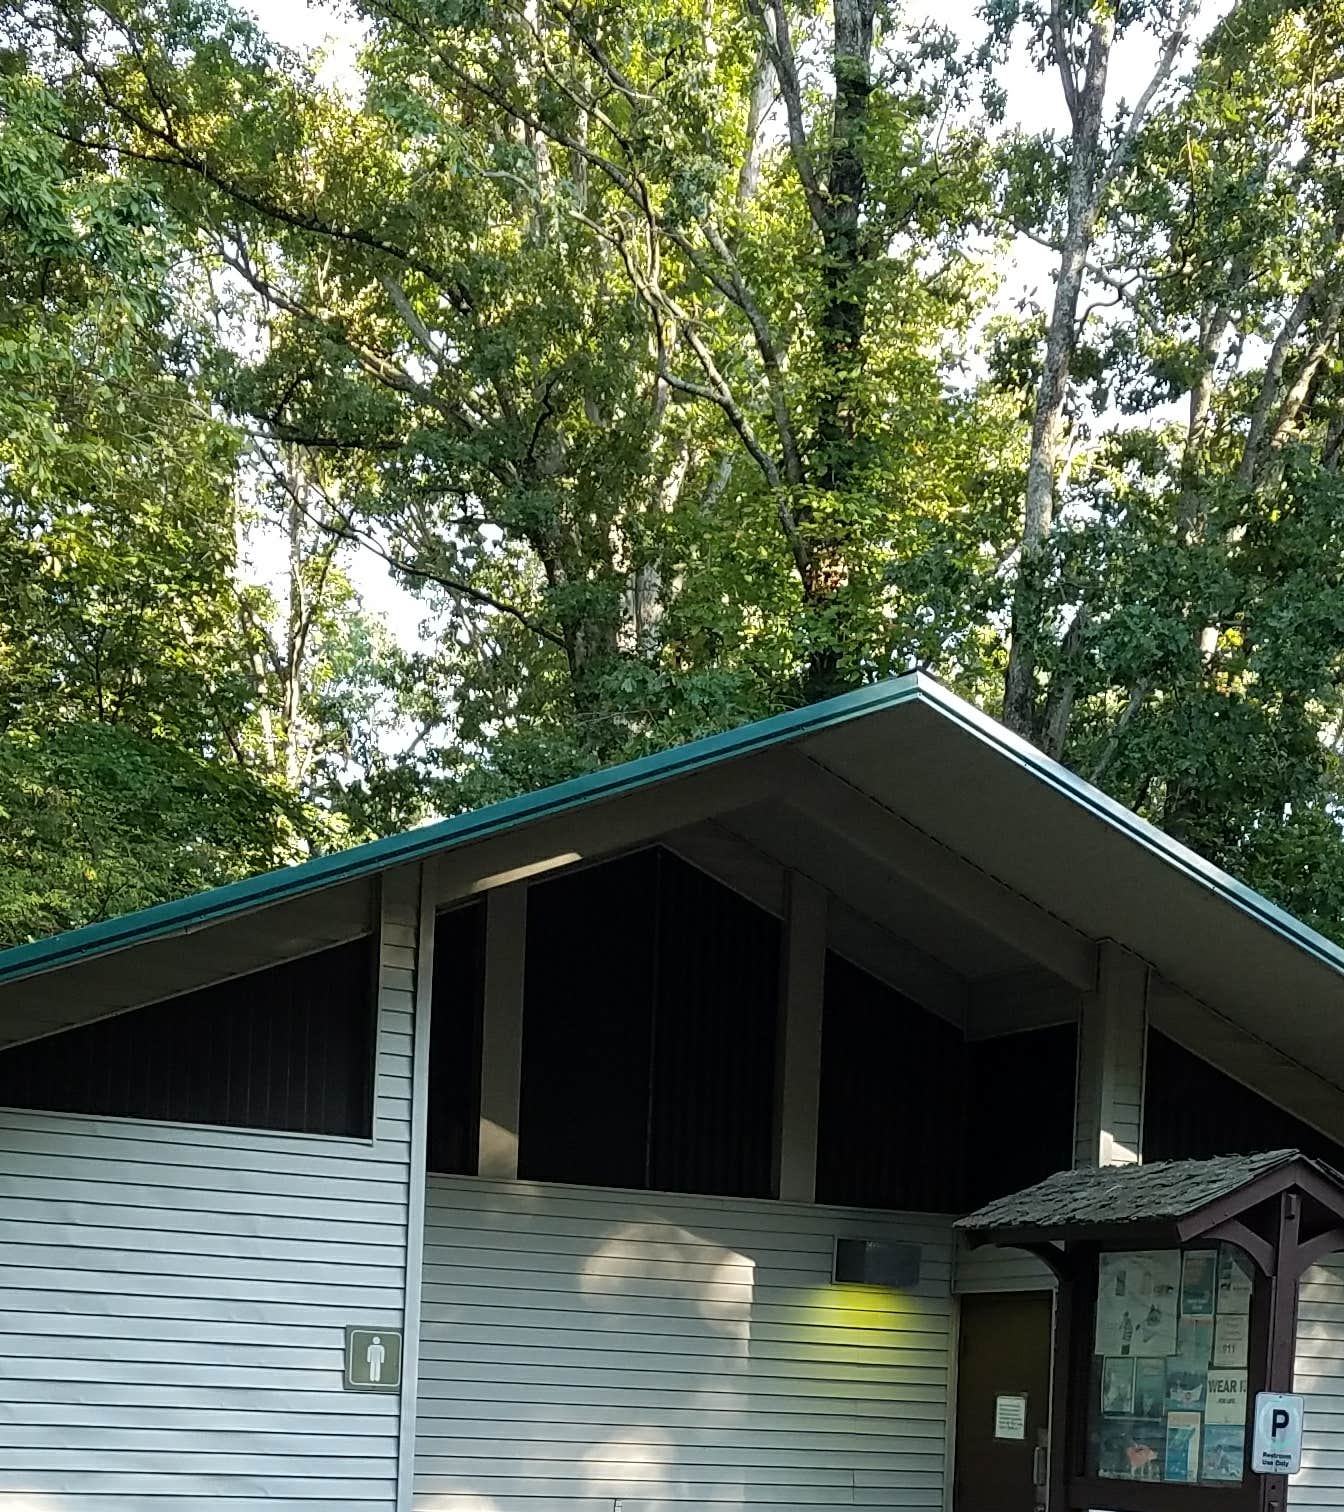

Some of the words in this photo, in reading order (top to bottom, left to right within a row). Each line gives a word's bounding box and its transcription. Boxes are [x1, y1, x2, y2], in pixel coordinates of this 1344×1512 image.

[1208, 1379, 1237, 1393] WEAR
[1271, 1408, 1290, 1438] P
[1262, 1451, 1292, 1460] Restroom
[1275, 1459, 1289, 1468] Only
